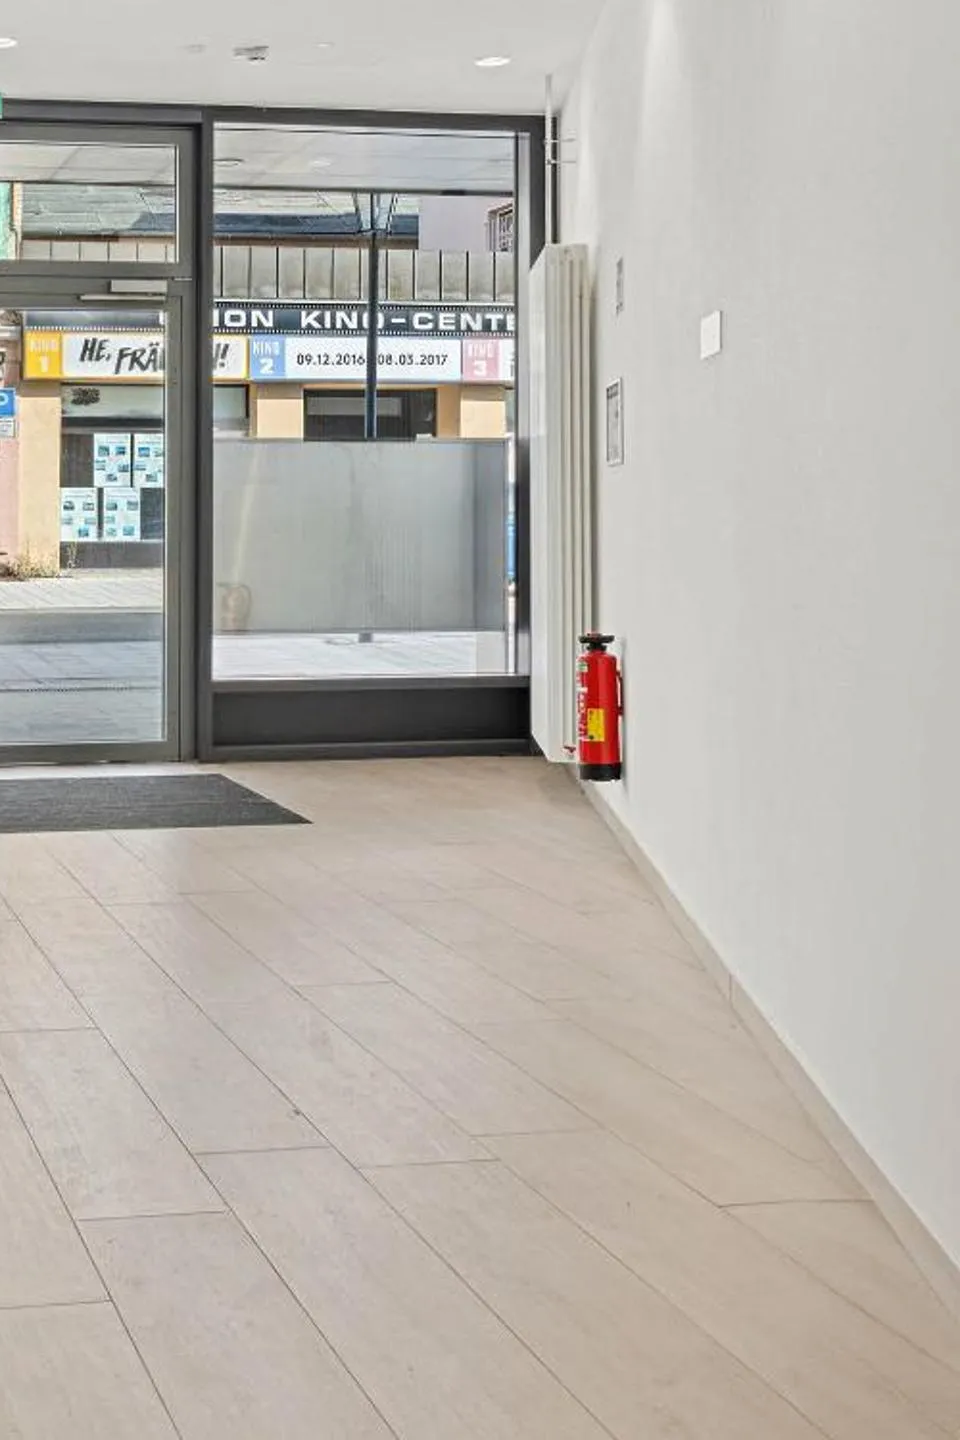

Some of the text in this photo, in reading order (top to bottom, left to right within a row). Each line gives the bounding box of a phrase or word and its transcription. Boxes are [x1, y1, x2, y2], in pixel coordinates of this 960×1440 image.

[79, 337, 111, 362] HE,
[39, 357, 49, 373] 1
[259, 357, 274, 375] 2
[296, 353, 365, 366] 09.12.2016
[473, 360, 488, 377] 3
